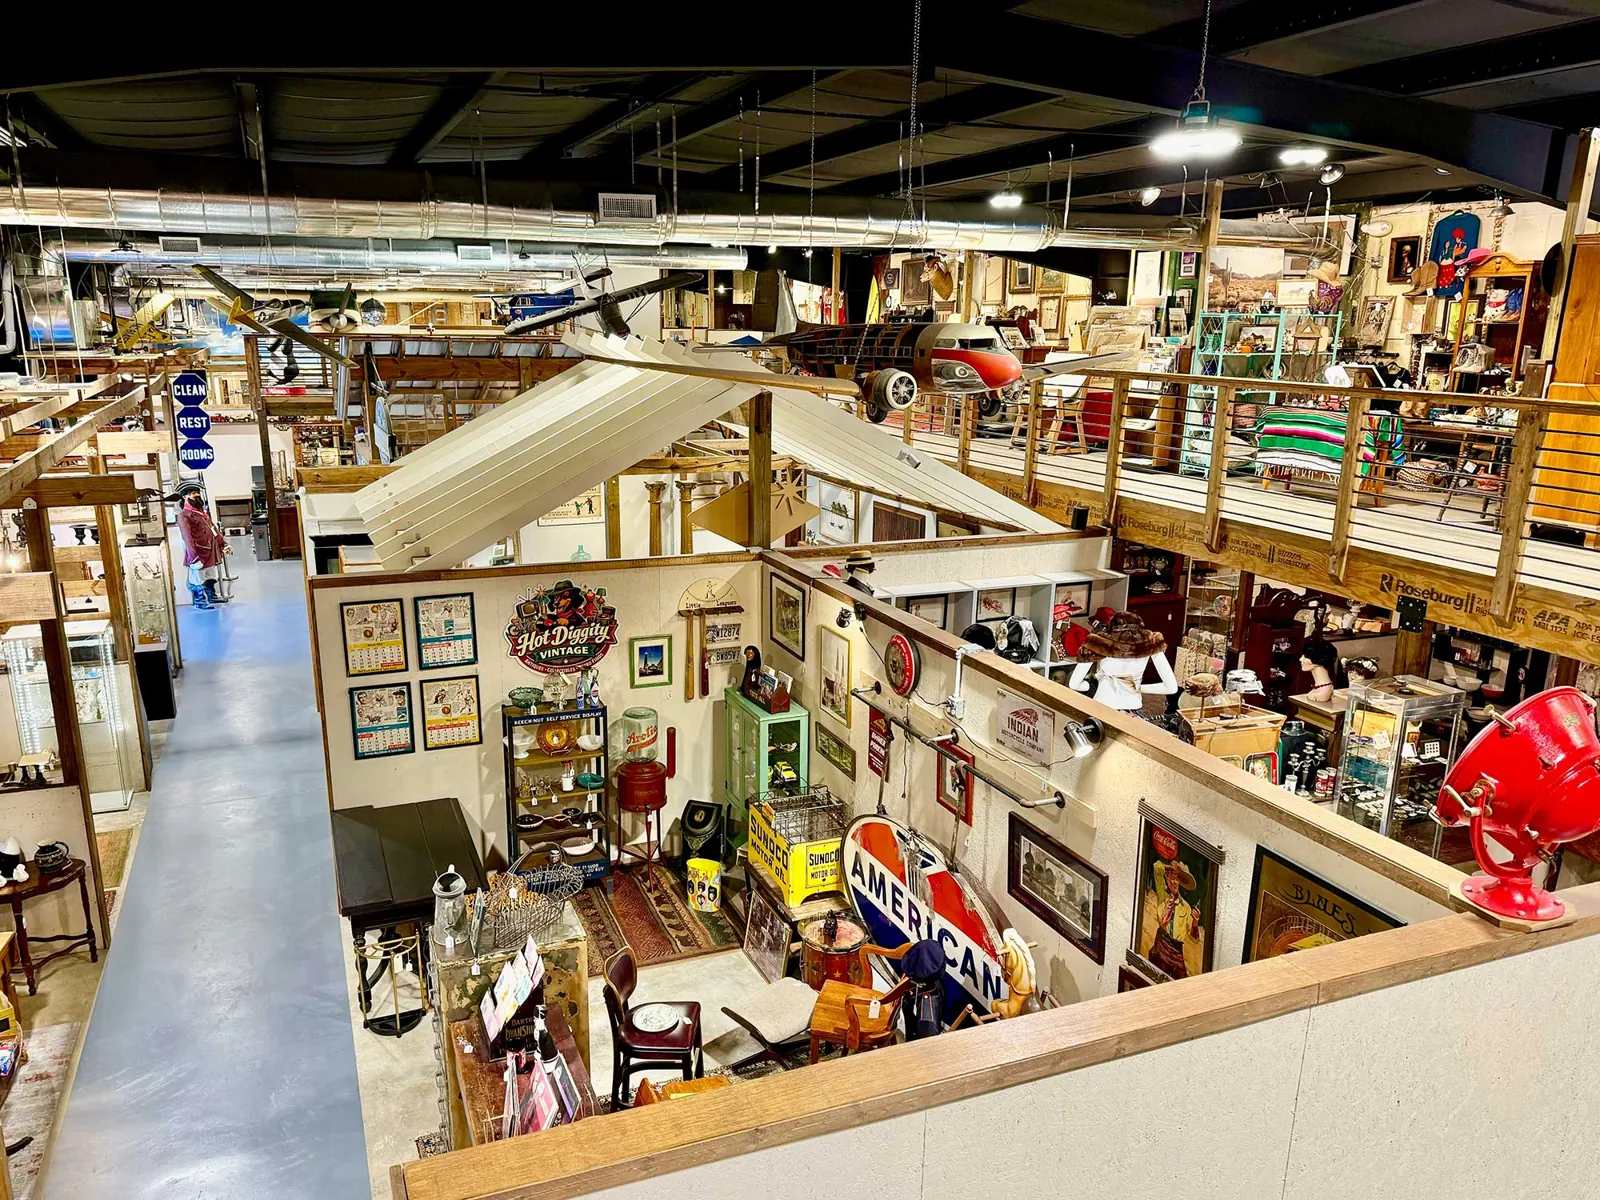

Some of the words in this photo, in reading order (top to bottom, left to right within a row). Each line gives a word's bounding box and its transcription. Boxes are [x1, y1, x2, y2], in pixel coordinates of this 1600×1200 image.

[173, 384, 207, 396] CLEAN
[179, 416, 208, 429] REST
[181, 448, 214, 460] ROOMS
[1127, 517, 1169, 537] Roseburg
[1396, 579, 1464, 611] Roseburg
[1475, 606, 1491, 618] Rigi
[1533, 609, 1570, 628] APA
[1549, 623, 1568, 635] 1125
[1574, 620, 1593, 632] APA
[516, 630, 551, 657] Hot
[551, 622, 610, 646] Diggity
[540, 646, 589, 659] VINTAGE
[1007, 716, 1039, 743] INDIAN
[1026, 740, 1045, 755] COMPANY
[750, 814, 788, 871] SUNOCO
[751, 838, 773, 869] MOTOR
[775, 865, 787, 886] OIL
[809, 848, 839, 866] SUNOCO
[810, 869, 828, 879] MOTOR
[830, 869, 838, 877] OIL
[851, 851, 1001, 1001] AMERICAN
[511, 1017, 534, 1027] BARTO
